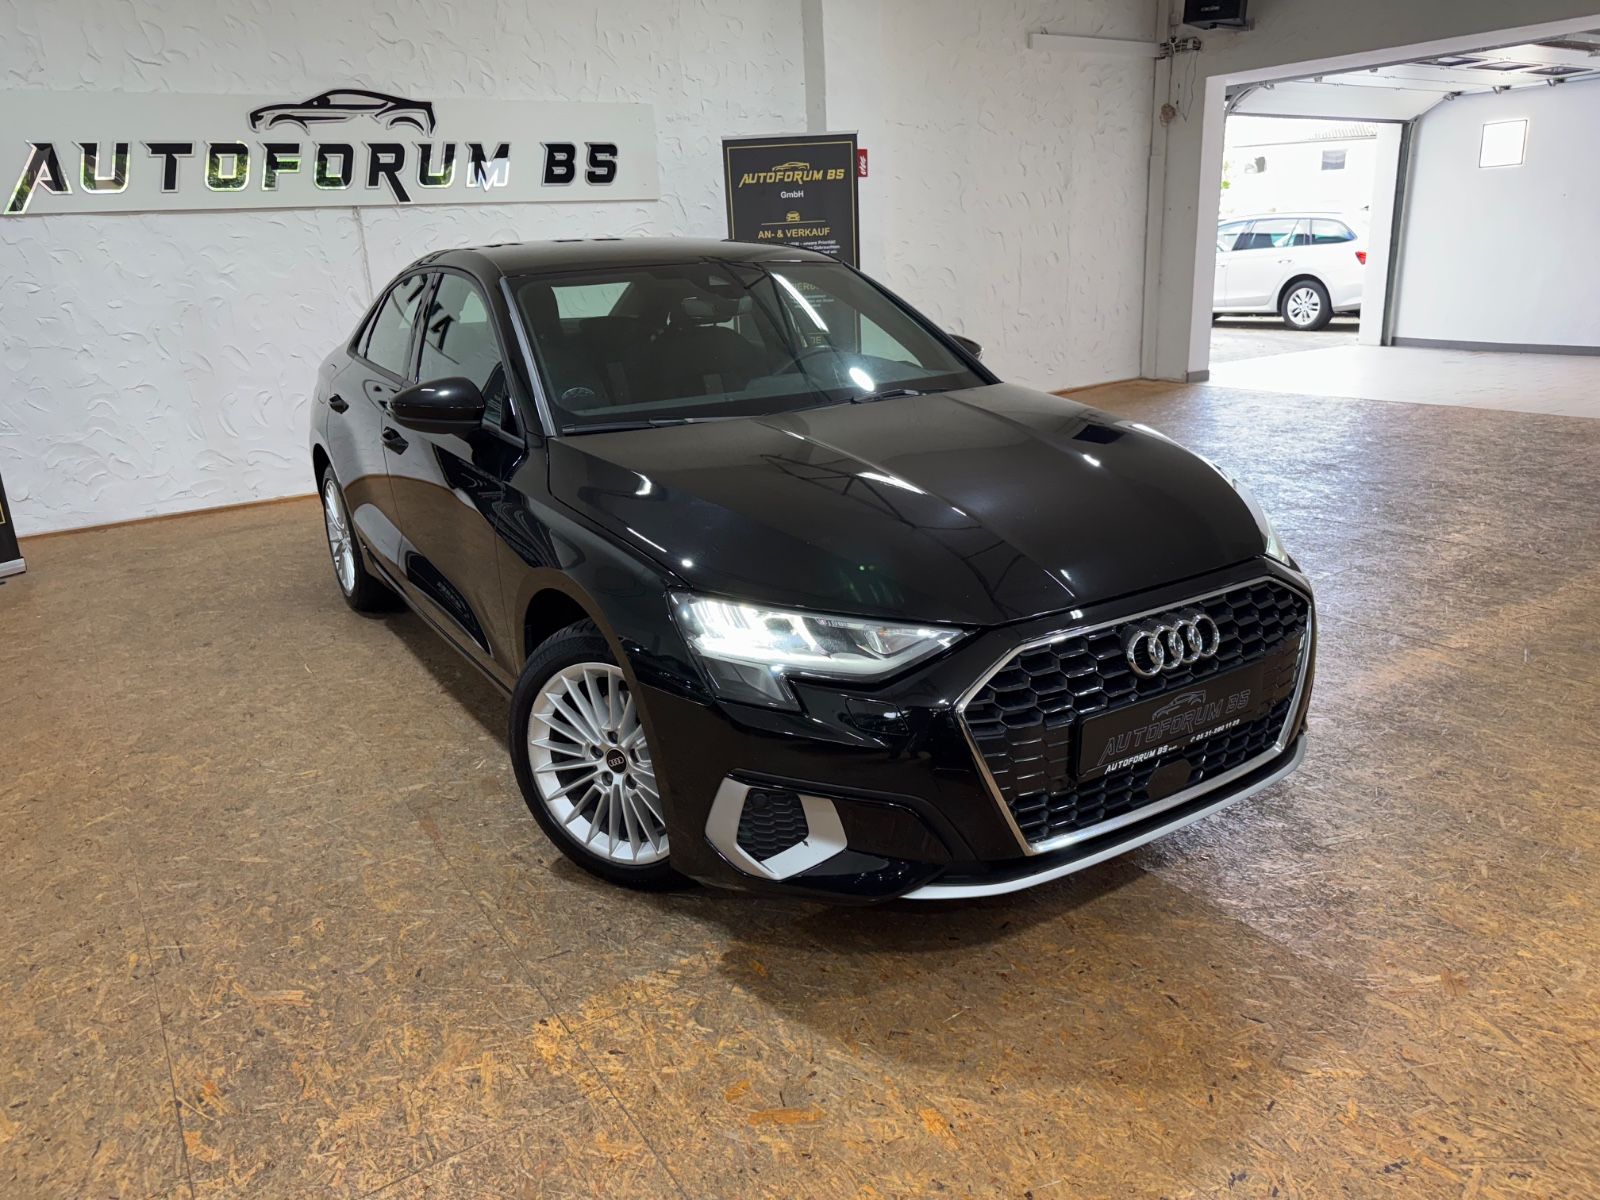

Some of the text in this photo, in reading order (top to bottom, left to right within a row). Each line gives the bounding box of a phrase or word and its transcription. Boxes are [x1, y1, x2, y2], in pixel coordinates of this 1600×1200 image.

[3, 139, 619, 215] AUTOFORUM BS
[738, 168, 846, 188] AUTOFORUM BS
[780, 190, 804, 199] GmbH
[757, 227, 831, 239] AN- & VERKAUF
[1097, 698, 1224, 767] AUTOFORUM
[1104, 749, 1157, 775] AUTOFORUM
